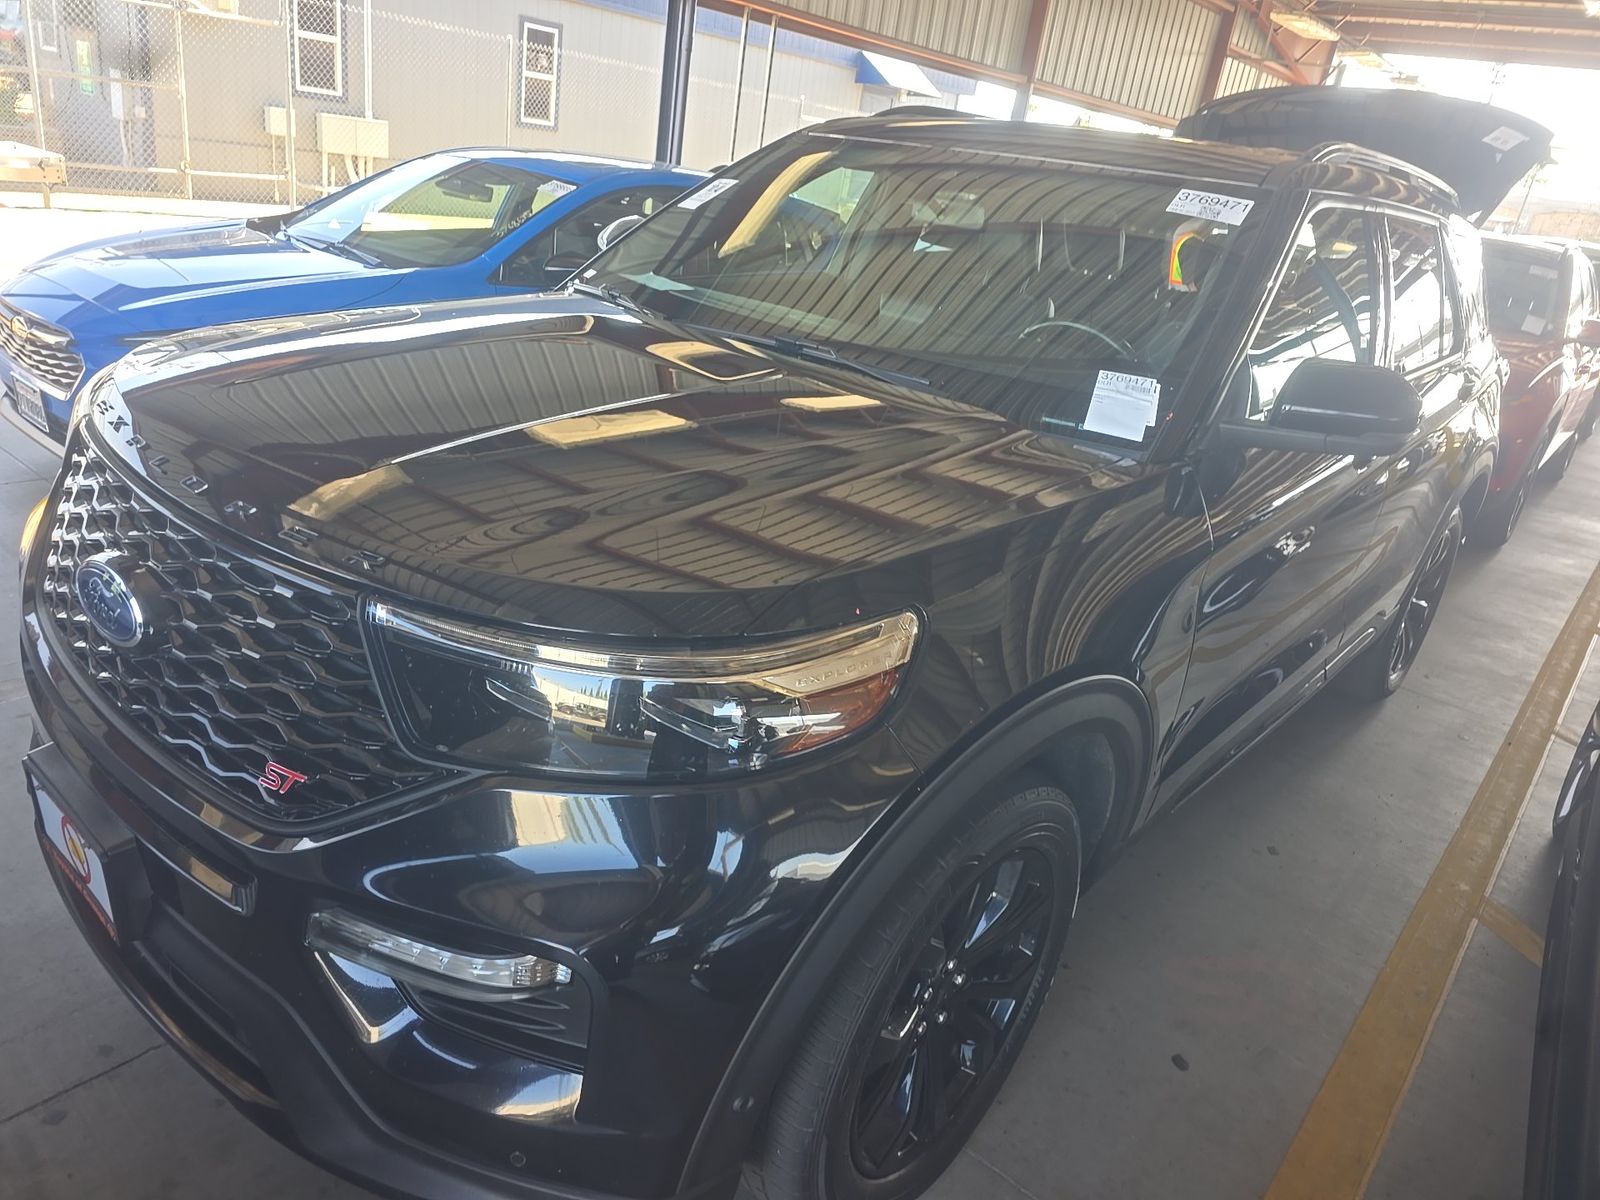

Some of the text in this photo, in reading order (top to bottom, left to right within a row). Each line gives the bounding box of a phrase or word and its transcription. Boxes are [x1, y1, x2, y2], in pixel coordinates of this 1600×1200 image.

[1178, 191, 1250, 213] 3769471
[1101, 371, 1155, 388] 3769471
[96, 399, 386, 573] EXPLORER
[258, 761, 308, 794] ST
